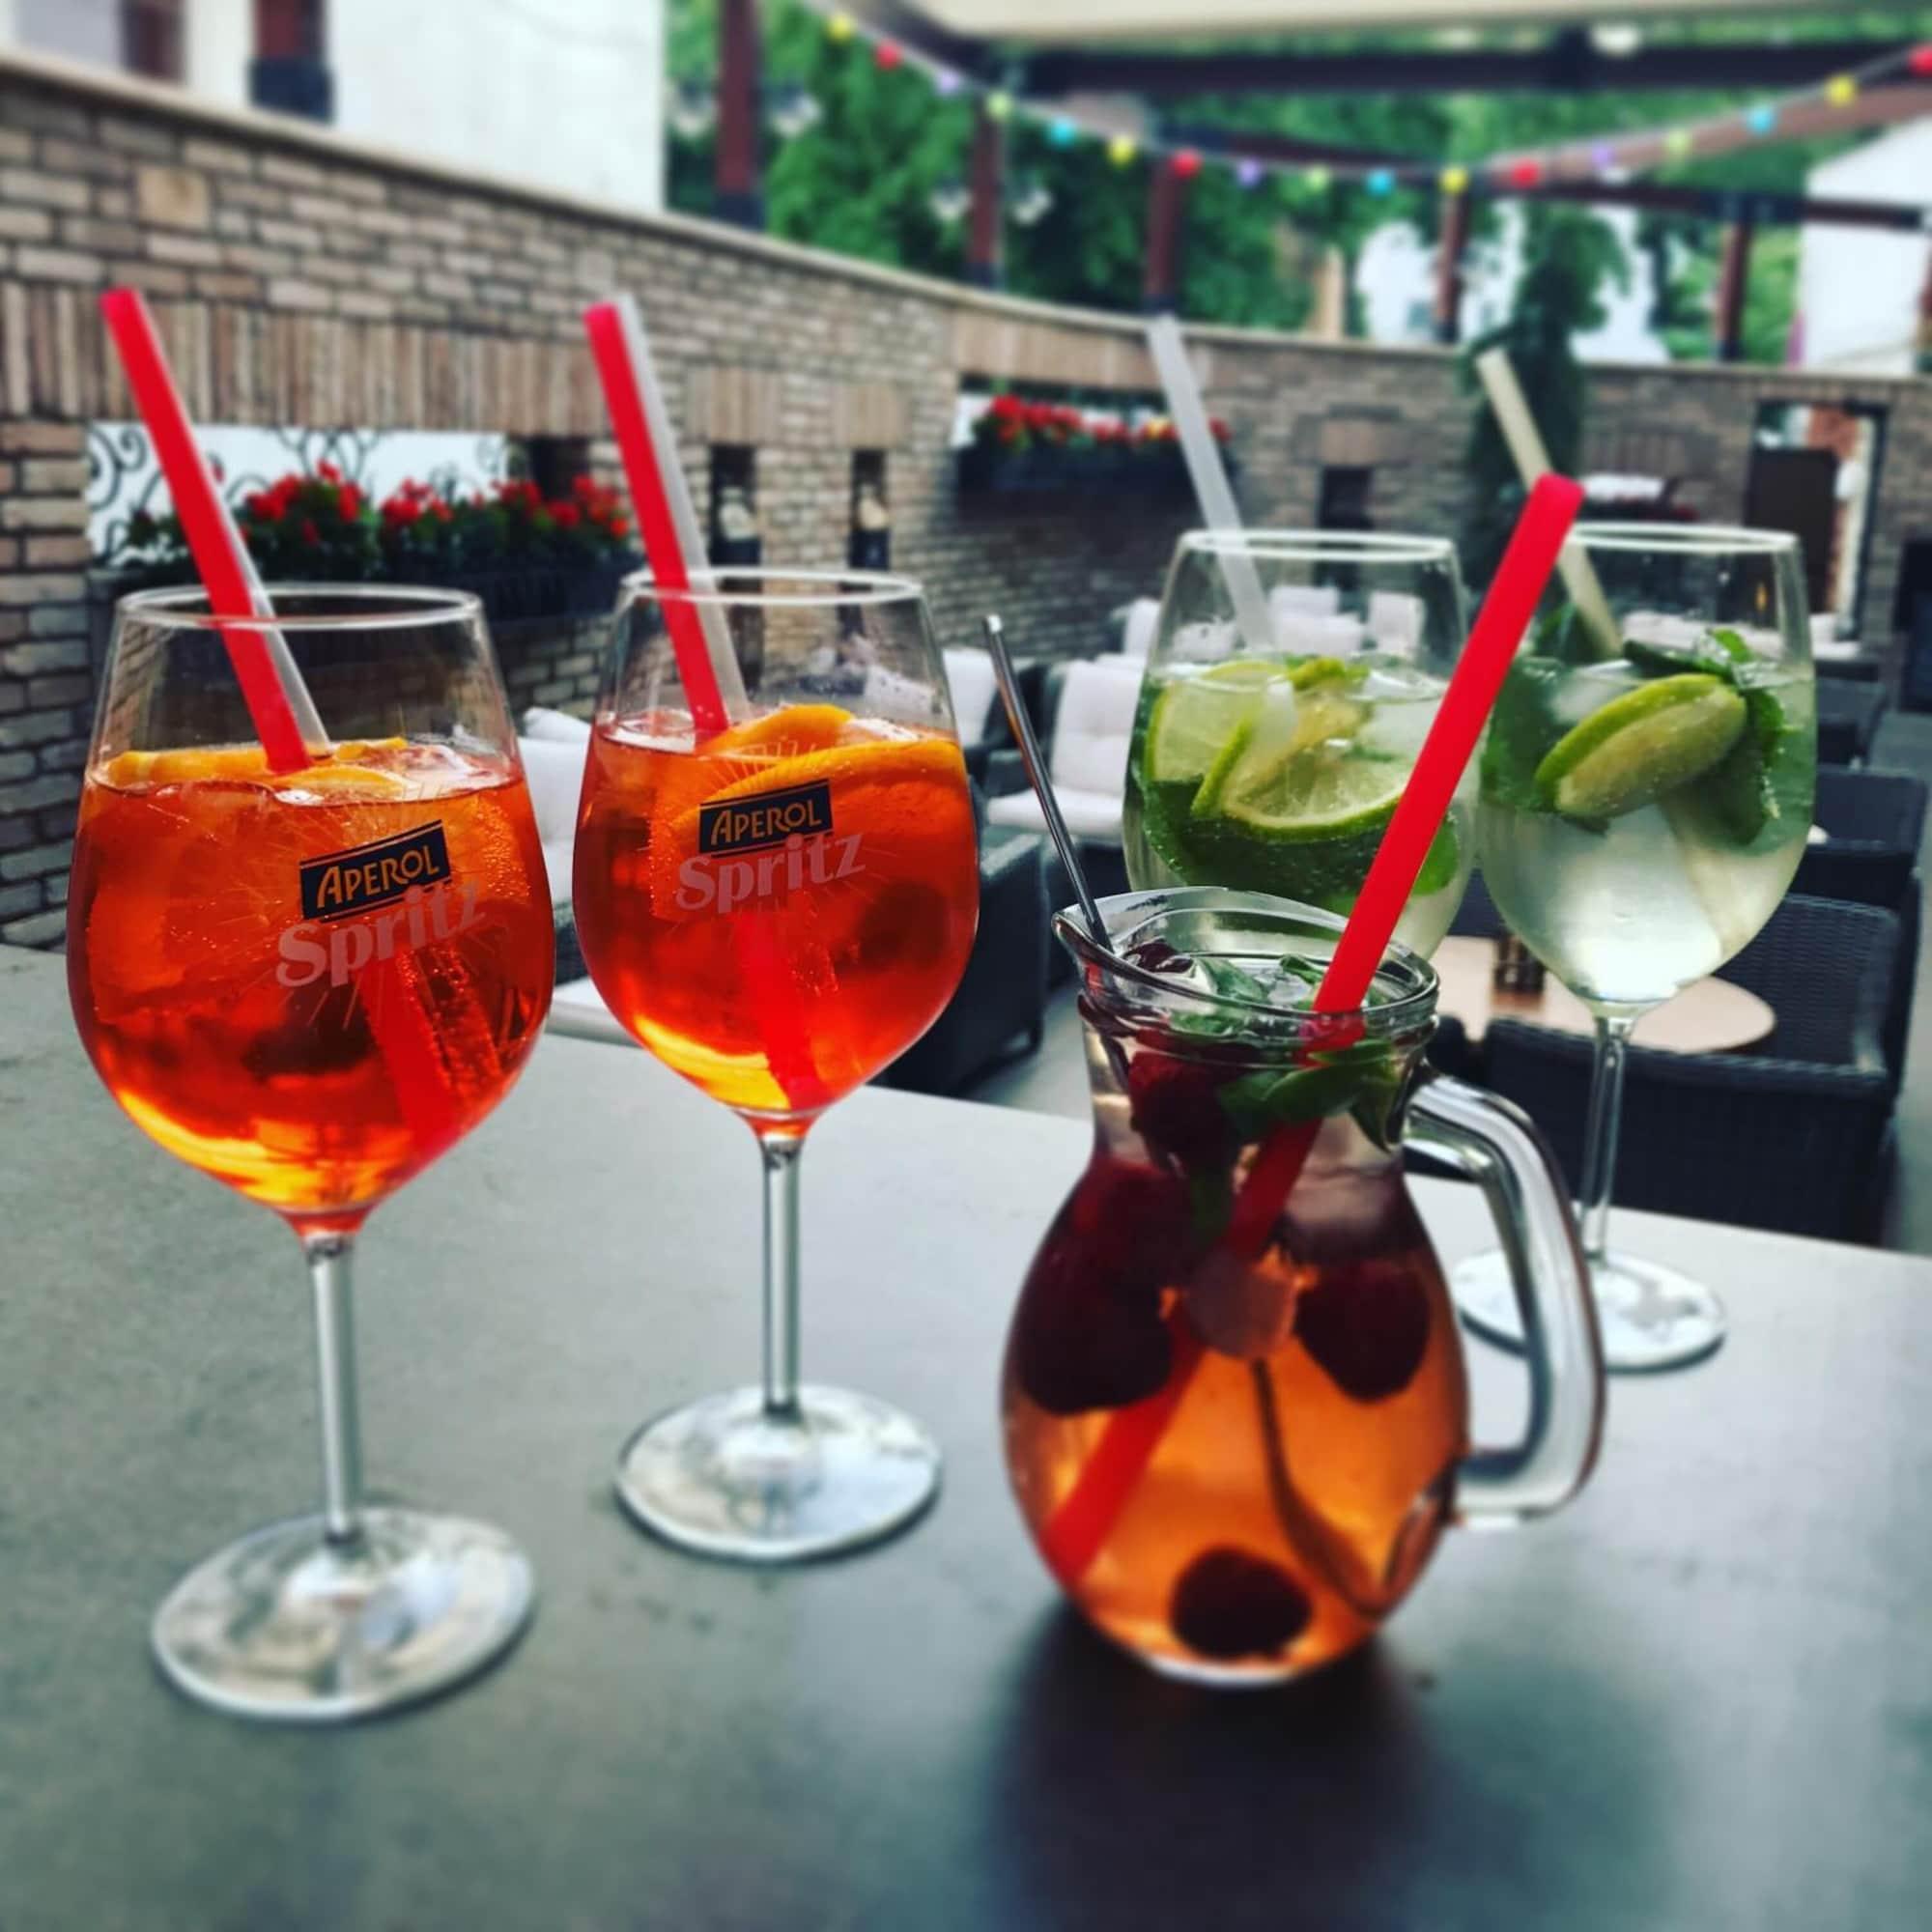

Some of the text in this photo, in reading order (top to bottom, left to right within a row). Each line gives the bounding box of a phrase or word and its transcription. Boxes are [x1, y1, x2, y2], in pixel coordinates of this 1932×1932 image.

[710, 799, 822, 846] APEROL
[316, 844, 440, 909] APEROL
[675, 833, 867, 915] Spritz
[275, 880, 486, 988] Spritz
